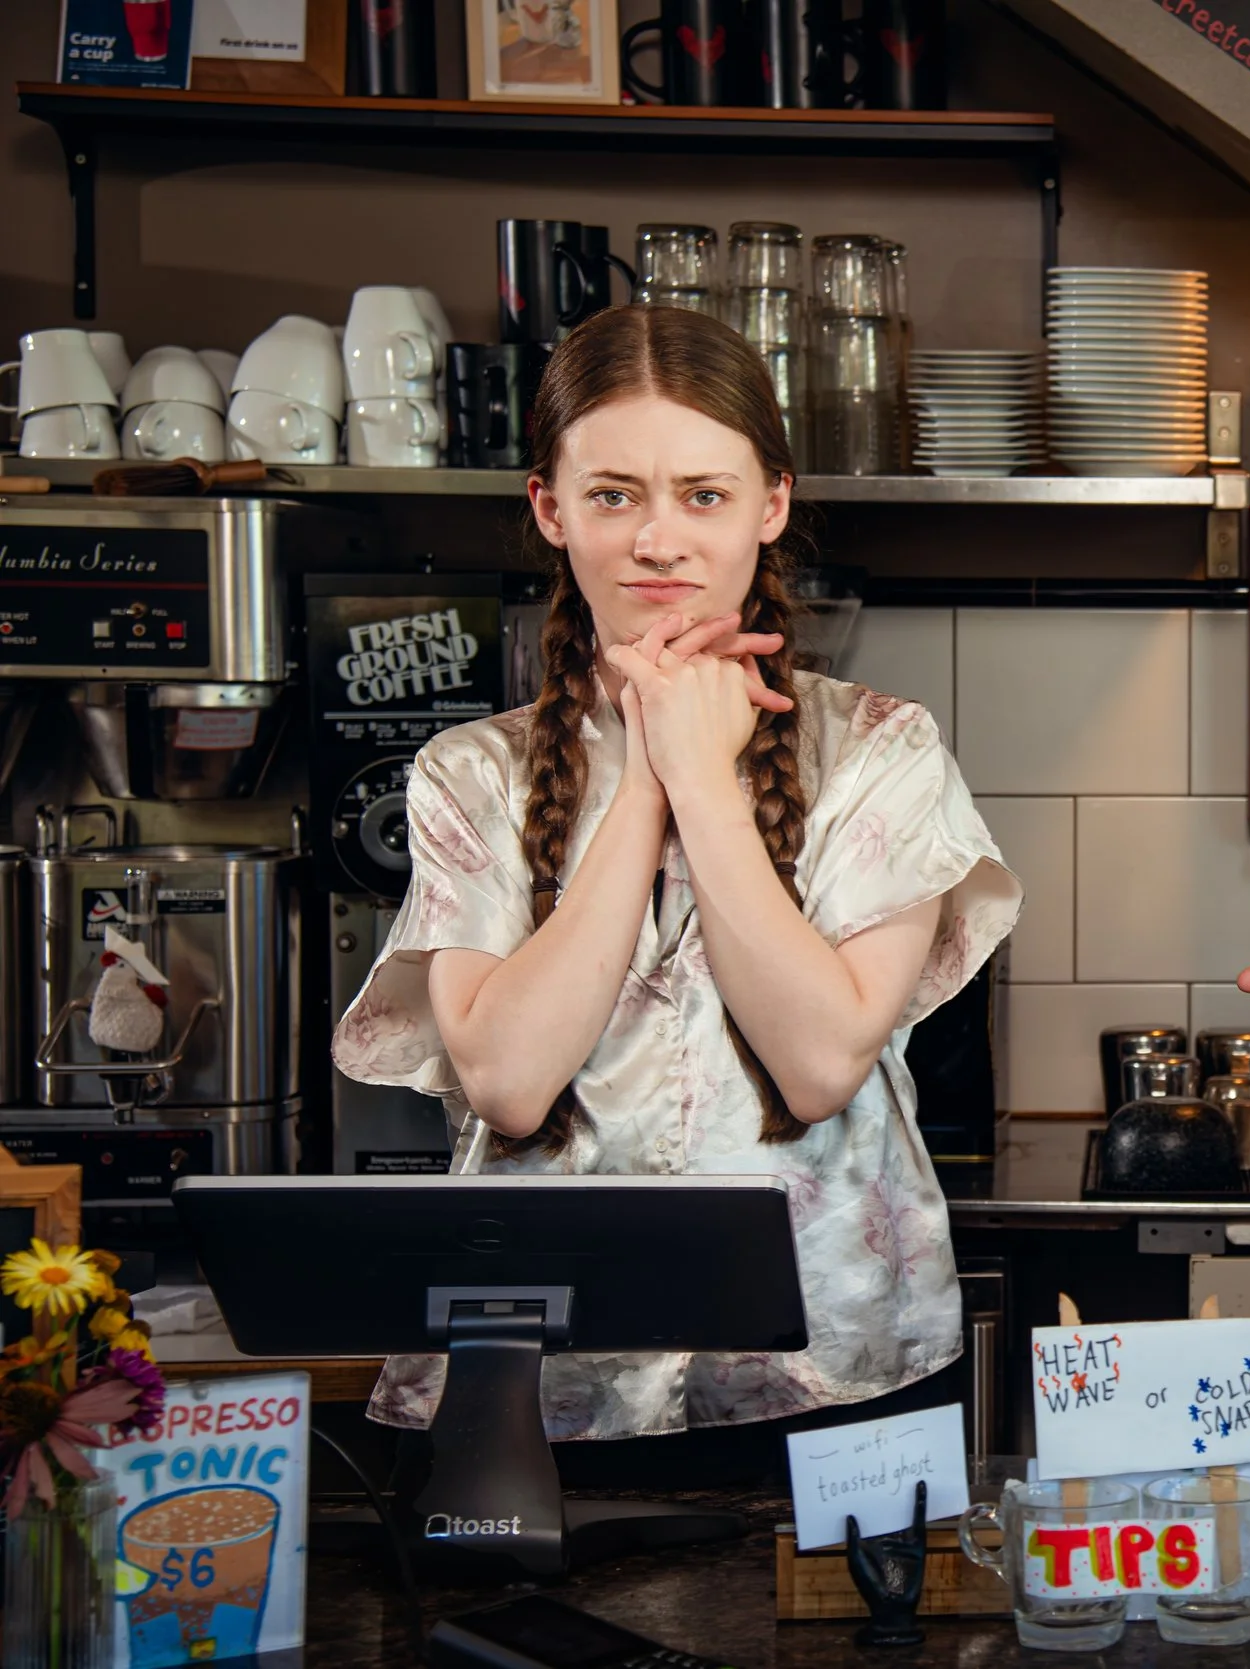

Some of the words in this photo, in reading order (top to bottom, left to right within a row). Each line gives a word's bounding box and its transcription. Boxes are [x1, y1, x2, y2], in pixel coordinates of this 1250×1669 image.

[69, 49, 80, 59] a
[83, 49, 114, 62] cup
[70, 33, 117, 48] Carry
[80, 542, 157, 572] Series
[349, 608, 462, 654] FRESH
[336, 633, 479, 681] GROUND
[346, 661, 473, 706] COFFEE
[1042, 1337, 1116, 1376] HEAT
[1045, 1377, 1117, 1413] WAVE
[1146, 1387, 1167, 1409] or
[854, 1428, 889, 1454] wifi
[128, 1442, 288, 1494] TONIC
[818, 1461, 887, 1502] toasted
[891, 1450, 935, 1496] ghost
[452, 1516, 520, 1535] toast
[161, 1547, 216, 1591] $6
[1028, 1524, 1201, 1589] TIPS
